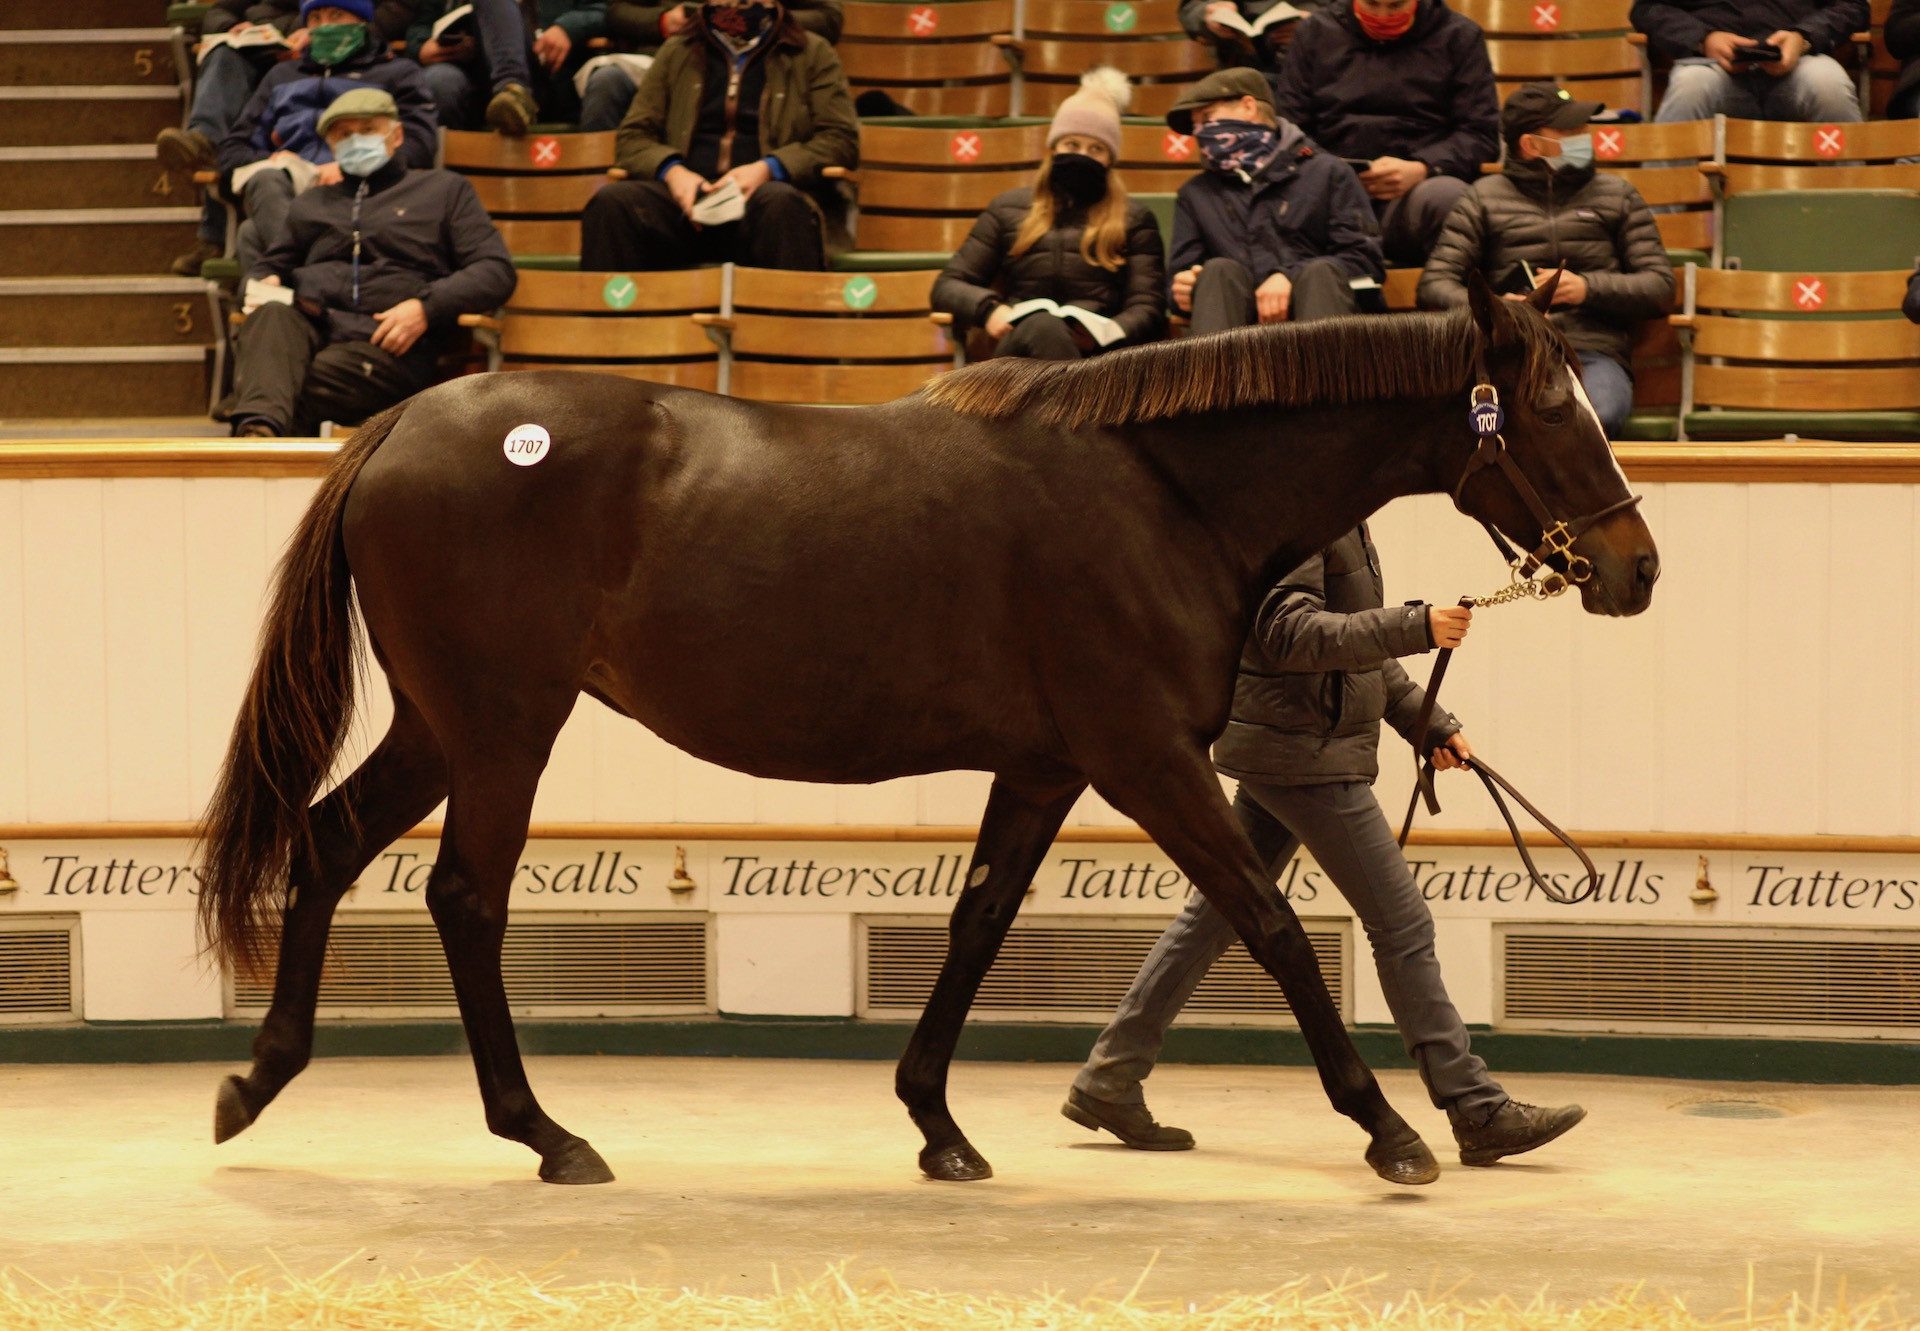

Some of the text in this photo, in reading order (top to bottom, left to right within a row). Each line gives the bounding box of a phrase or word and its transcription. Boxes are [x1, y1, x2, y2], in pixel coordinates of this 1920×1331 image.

[134, 48, 153, 77] 5
[151, 169, 172, 195] 4
[172, 303, 193, 334] 3
[1476, 412, 1497, 432] 1707
[509, 439, 543, 453] 1707
[722, 854, 969, 898] Tattersall
[1405, 859, 1665, 905] Tattersalls
